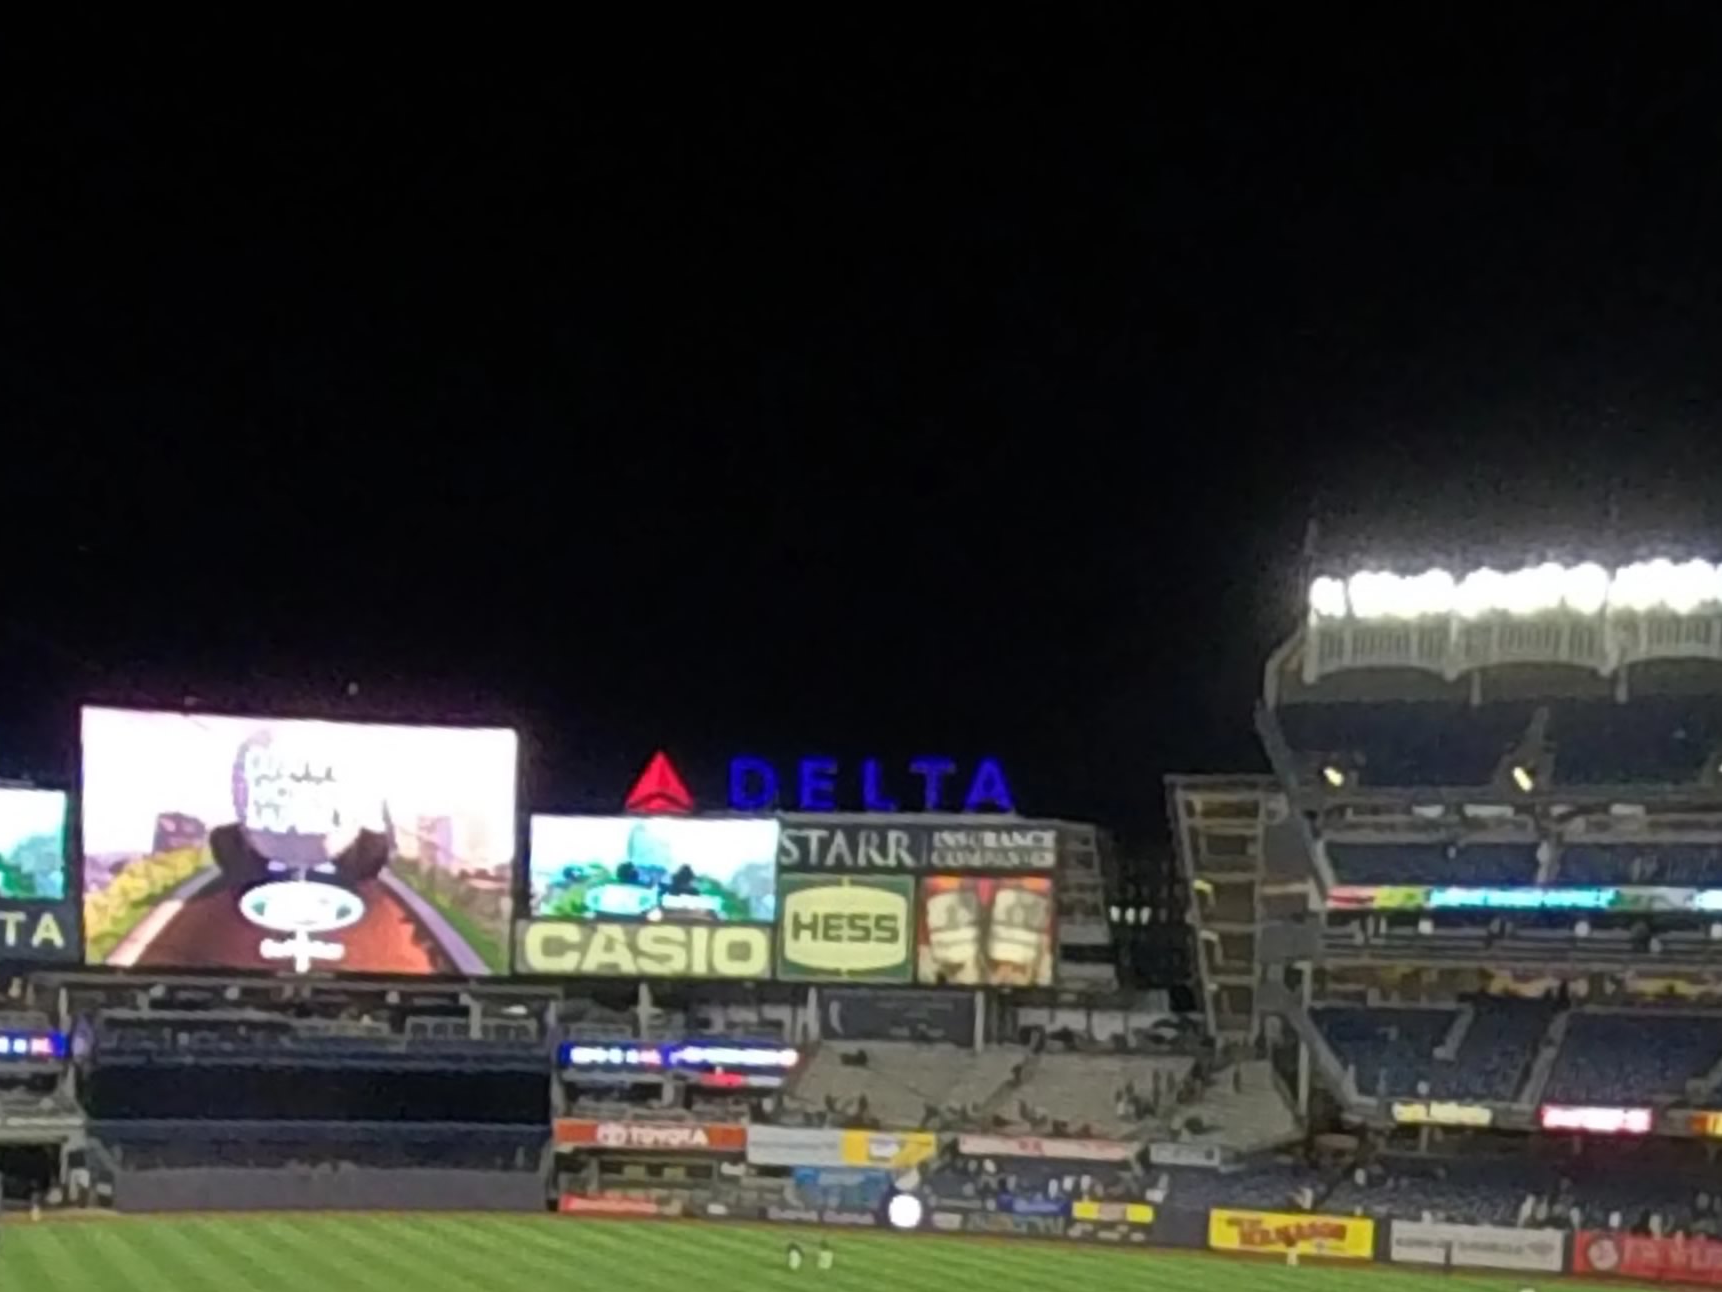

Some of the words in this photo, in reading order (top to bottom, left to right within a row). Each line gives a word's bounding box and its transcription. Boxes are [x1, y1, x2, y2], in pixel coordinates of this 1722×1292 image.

[727, 756, 1015, 813] DELTA
[780, 827, 917, 867] STARR
[524, 921, 769, 976] CASIO
[791, 912, 899, 943] HESS
